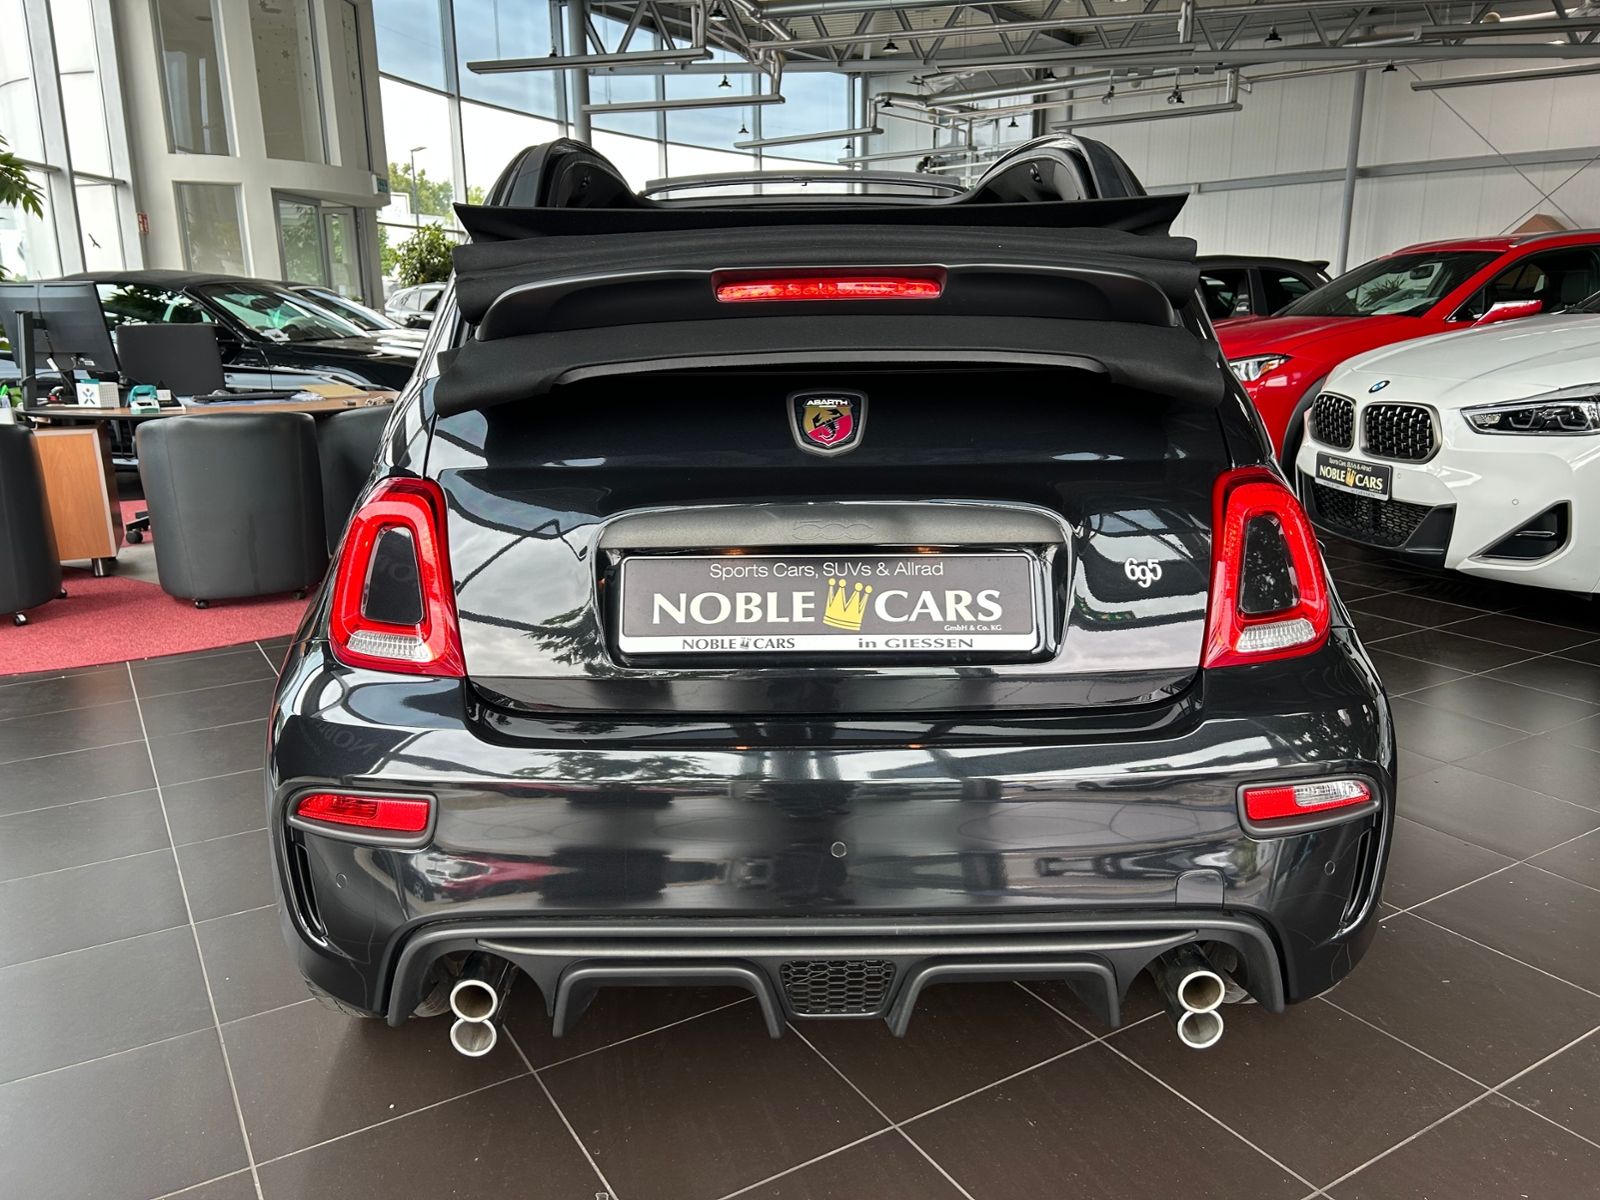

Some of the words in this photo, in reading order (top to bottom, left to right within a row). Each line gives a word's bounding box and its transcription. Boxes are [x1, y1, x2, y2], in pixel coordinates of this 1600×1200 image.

[1320, 465, 1346, 482] NOBLE
[1355, 474, 1383, 490] CARS
[709, 563, 769, 581] Sports
[772, 562, 819, 579] Cars,
[822, 561, 872, 577] SUVs
[875, 561, 890, 577] &
[893, 561, 944, 577] Allrad
[1124, 557, 1163, 588] 695
[652, 591, 815, 625] NOBLE
[874, 589, 1003, 623] CARS
[944, 624, 968, 632] GmbH
[682, 638, 737, 650] NOBLE
[753, 637, 796, 650] CARS
[858, 637, 877, 649] in
[884, 637, 974, 649] GIESSEN
